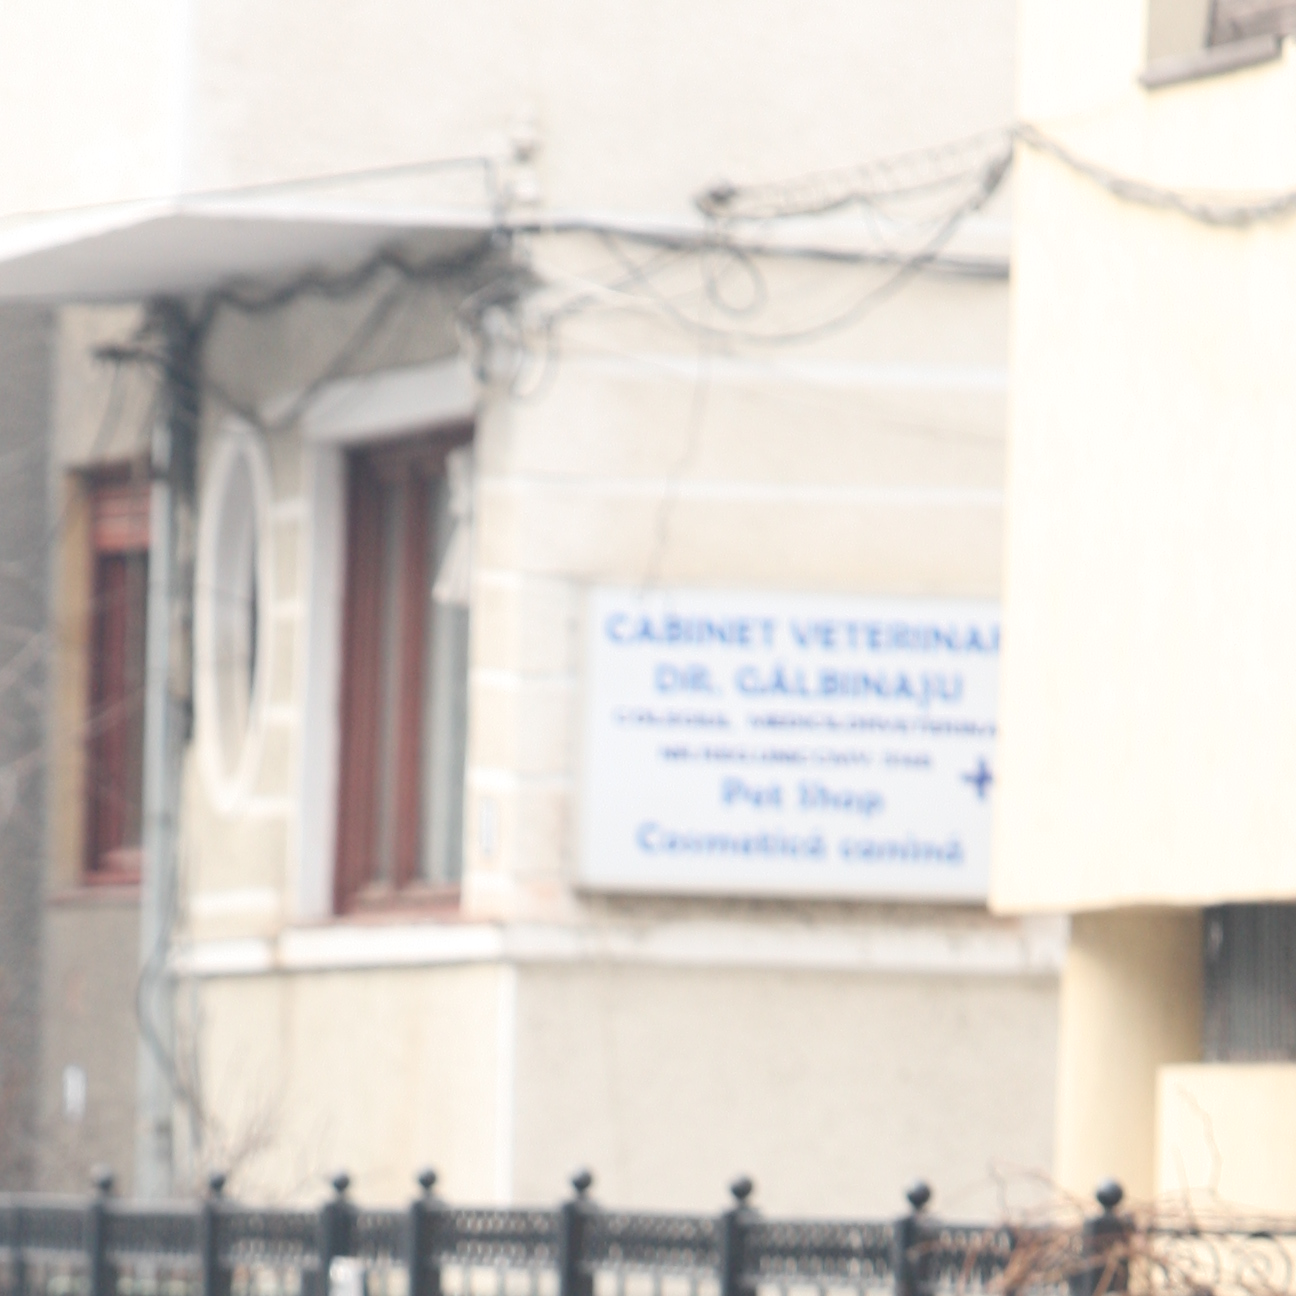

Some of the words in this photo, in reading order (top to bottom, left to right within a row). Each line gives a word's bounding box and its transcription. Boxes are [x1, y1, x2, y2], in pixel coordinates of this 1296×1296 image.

[605, 613, 777, 648] CABINET
[721, 776, 781, 809] Pet
[799, 781, 886, 818] Shop
